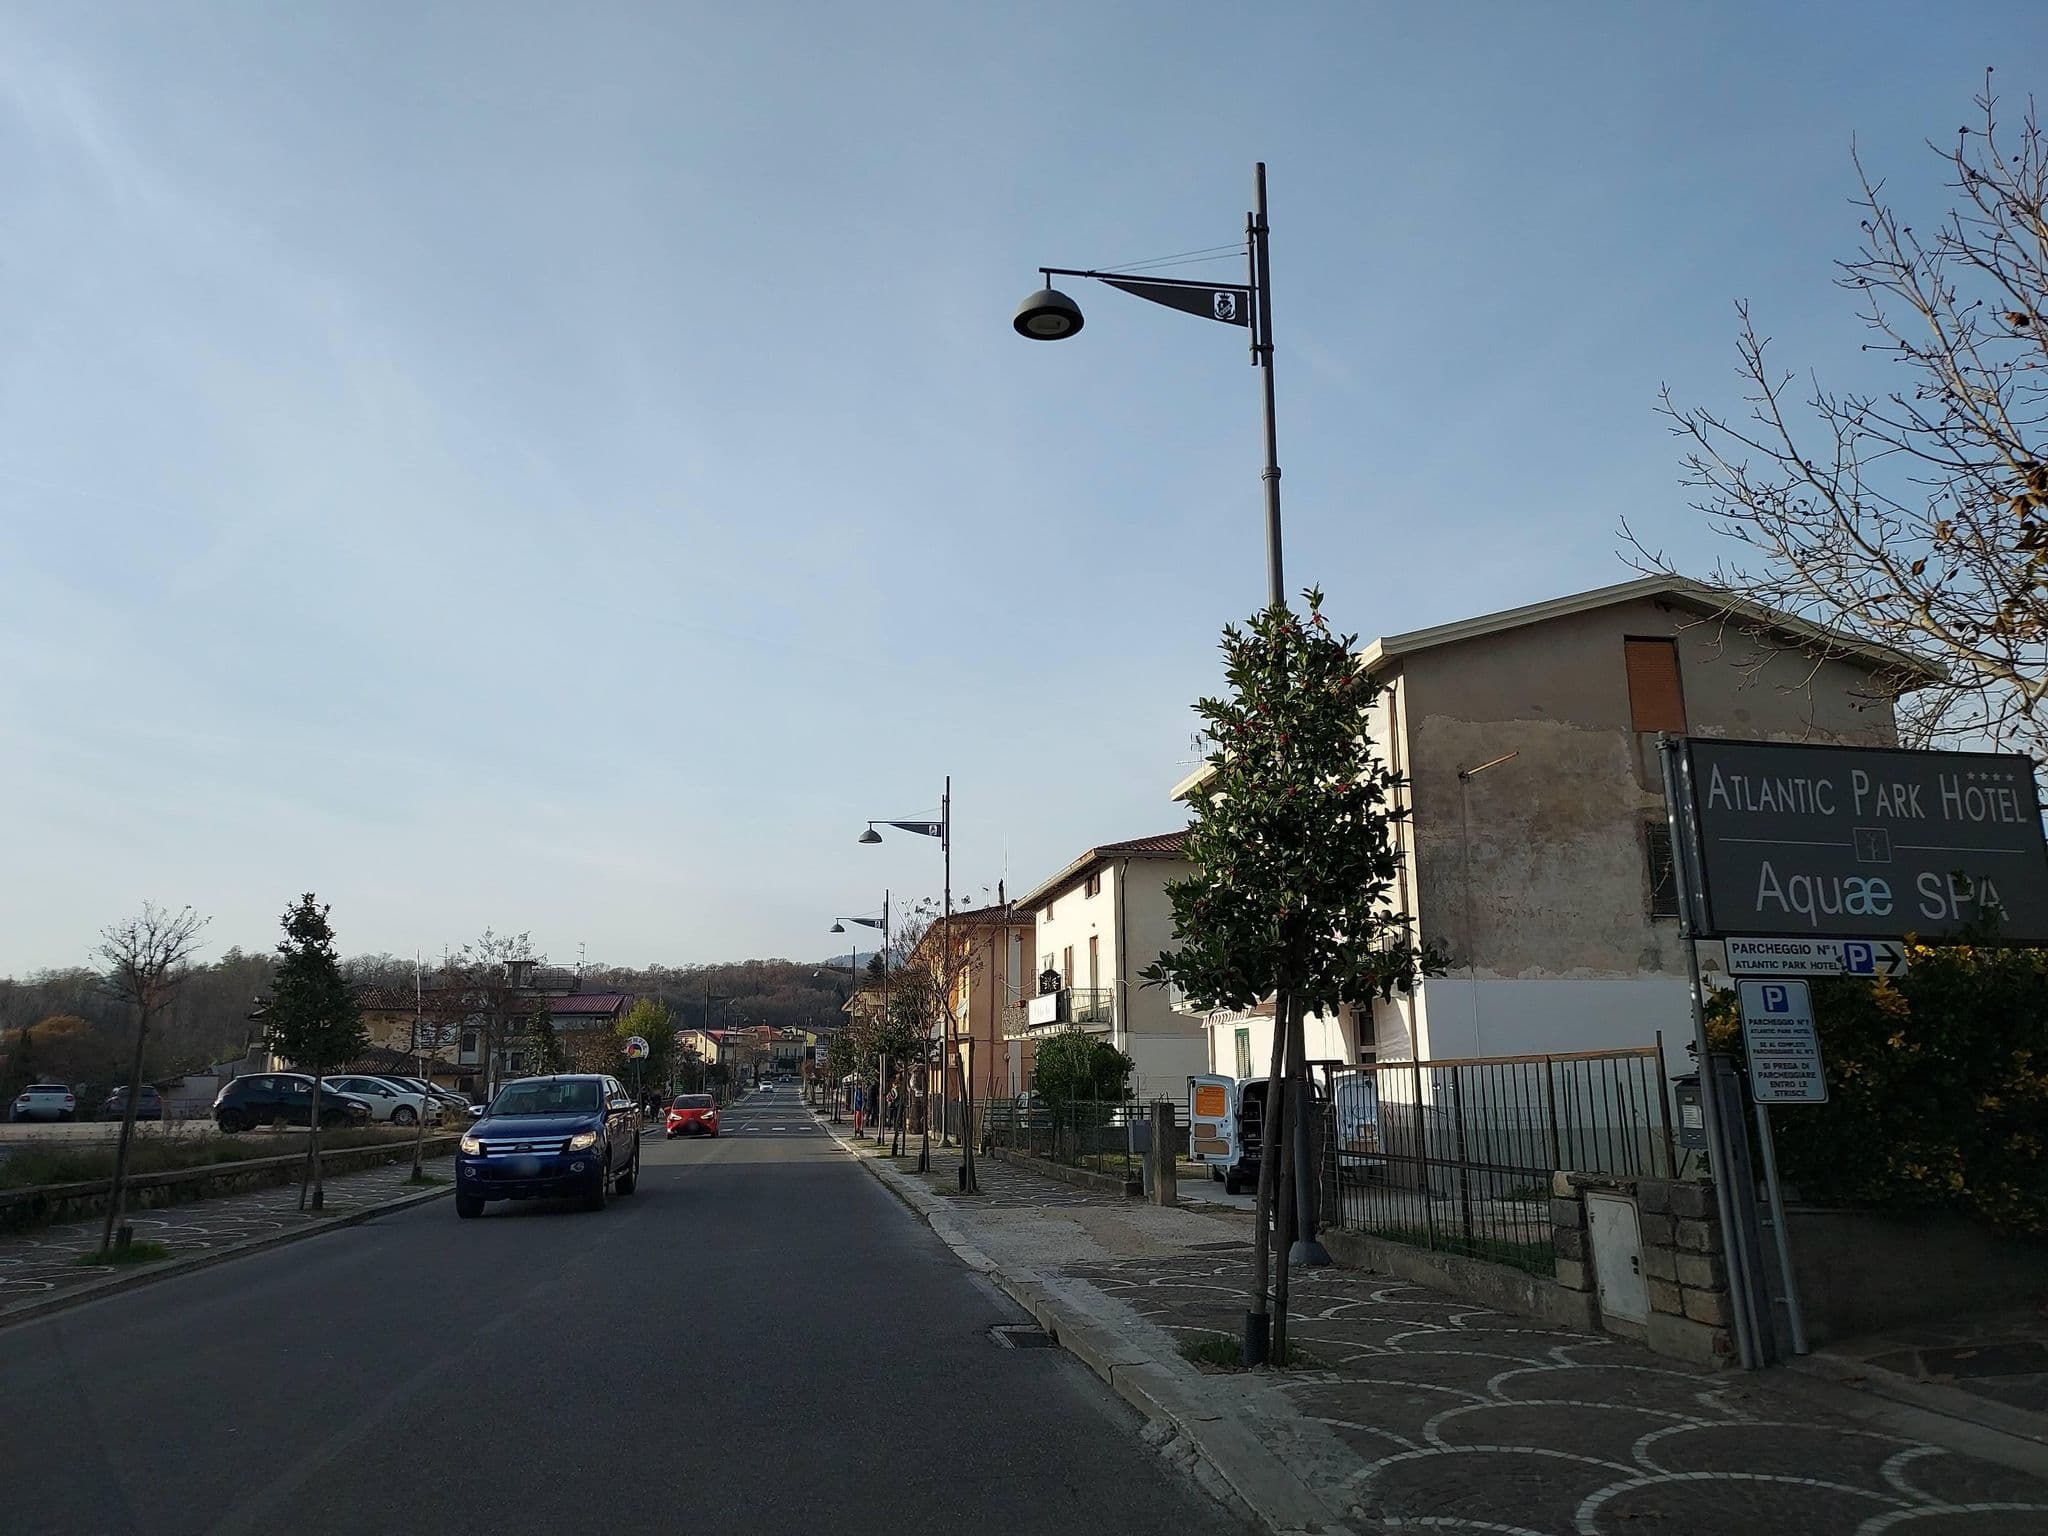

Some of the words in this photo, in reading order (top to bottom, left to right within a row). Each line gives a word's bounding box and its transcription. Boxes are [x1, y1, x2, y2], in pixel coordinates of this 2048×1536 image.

[1708, 762, 1837, 815] ATLANTIC
[1851, 769, 1926, 819] PARK
[1939, 773, 2028, 823] HOTEL
[1916, 872, 2010, 921] SPA
[1732, 943, 1811, 955] PARCHEGGIO
[1735, 960, 1779, 969] ATLANTIC
[1782, 961, 1807, 969] PARK
[1810, 961, 1840, 970] HOTEL
[1757, 1071, 1817, 1079] PARCHEGGIARE
[1769, 1080, 1796, 1088] ENTRO
[1798, 1080, 1809, 1088] LE
[1774, 1089, 1808, 1097] STRISCE
